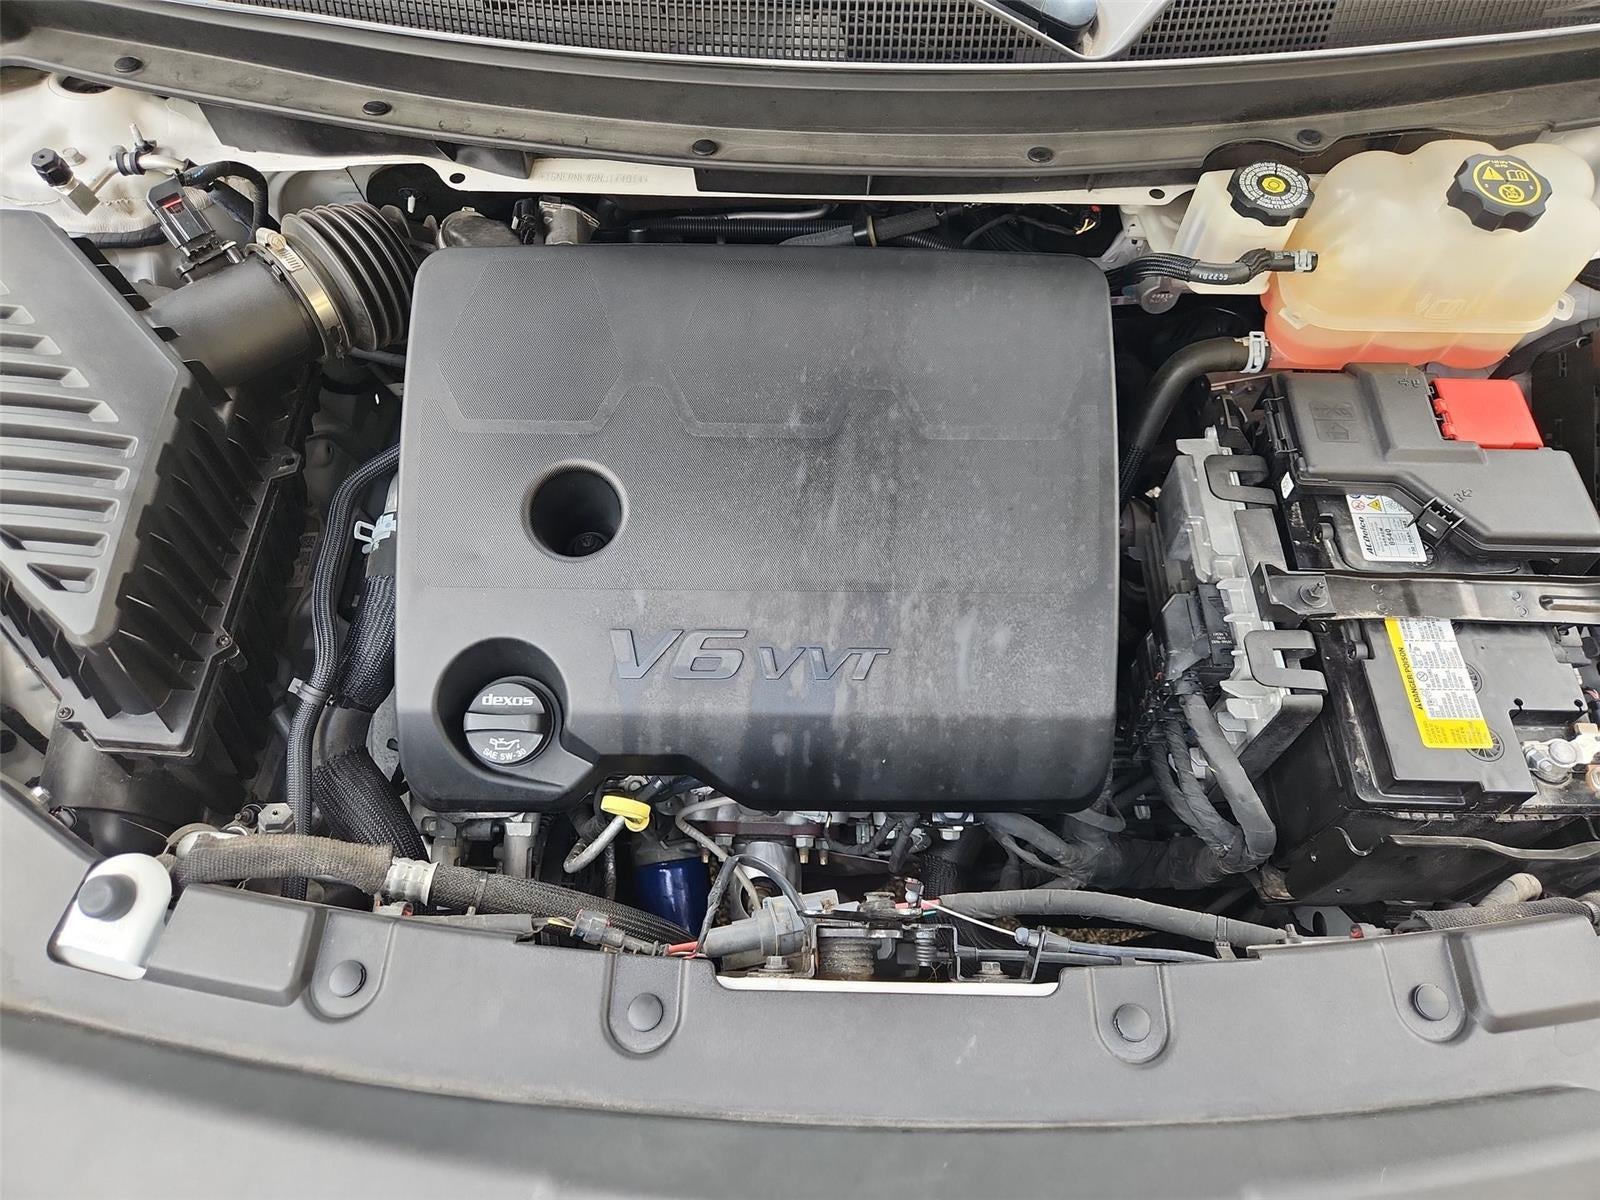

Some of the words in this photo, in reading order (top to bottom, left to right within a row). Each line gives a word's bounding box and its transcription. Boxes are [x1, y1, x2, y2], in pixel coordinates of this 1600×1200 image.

[1358, 516, 1374, 555] ACDelco
[609, 628, 748, 679] V6
[759, 646, 891, 680] VVT
[481, 693, 535, 706] dexos
[482, 747, 499, 760] SAE
[500, 748, 526, 761] 5W-30
